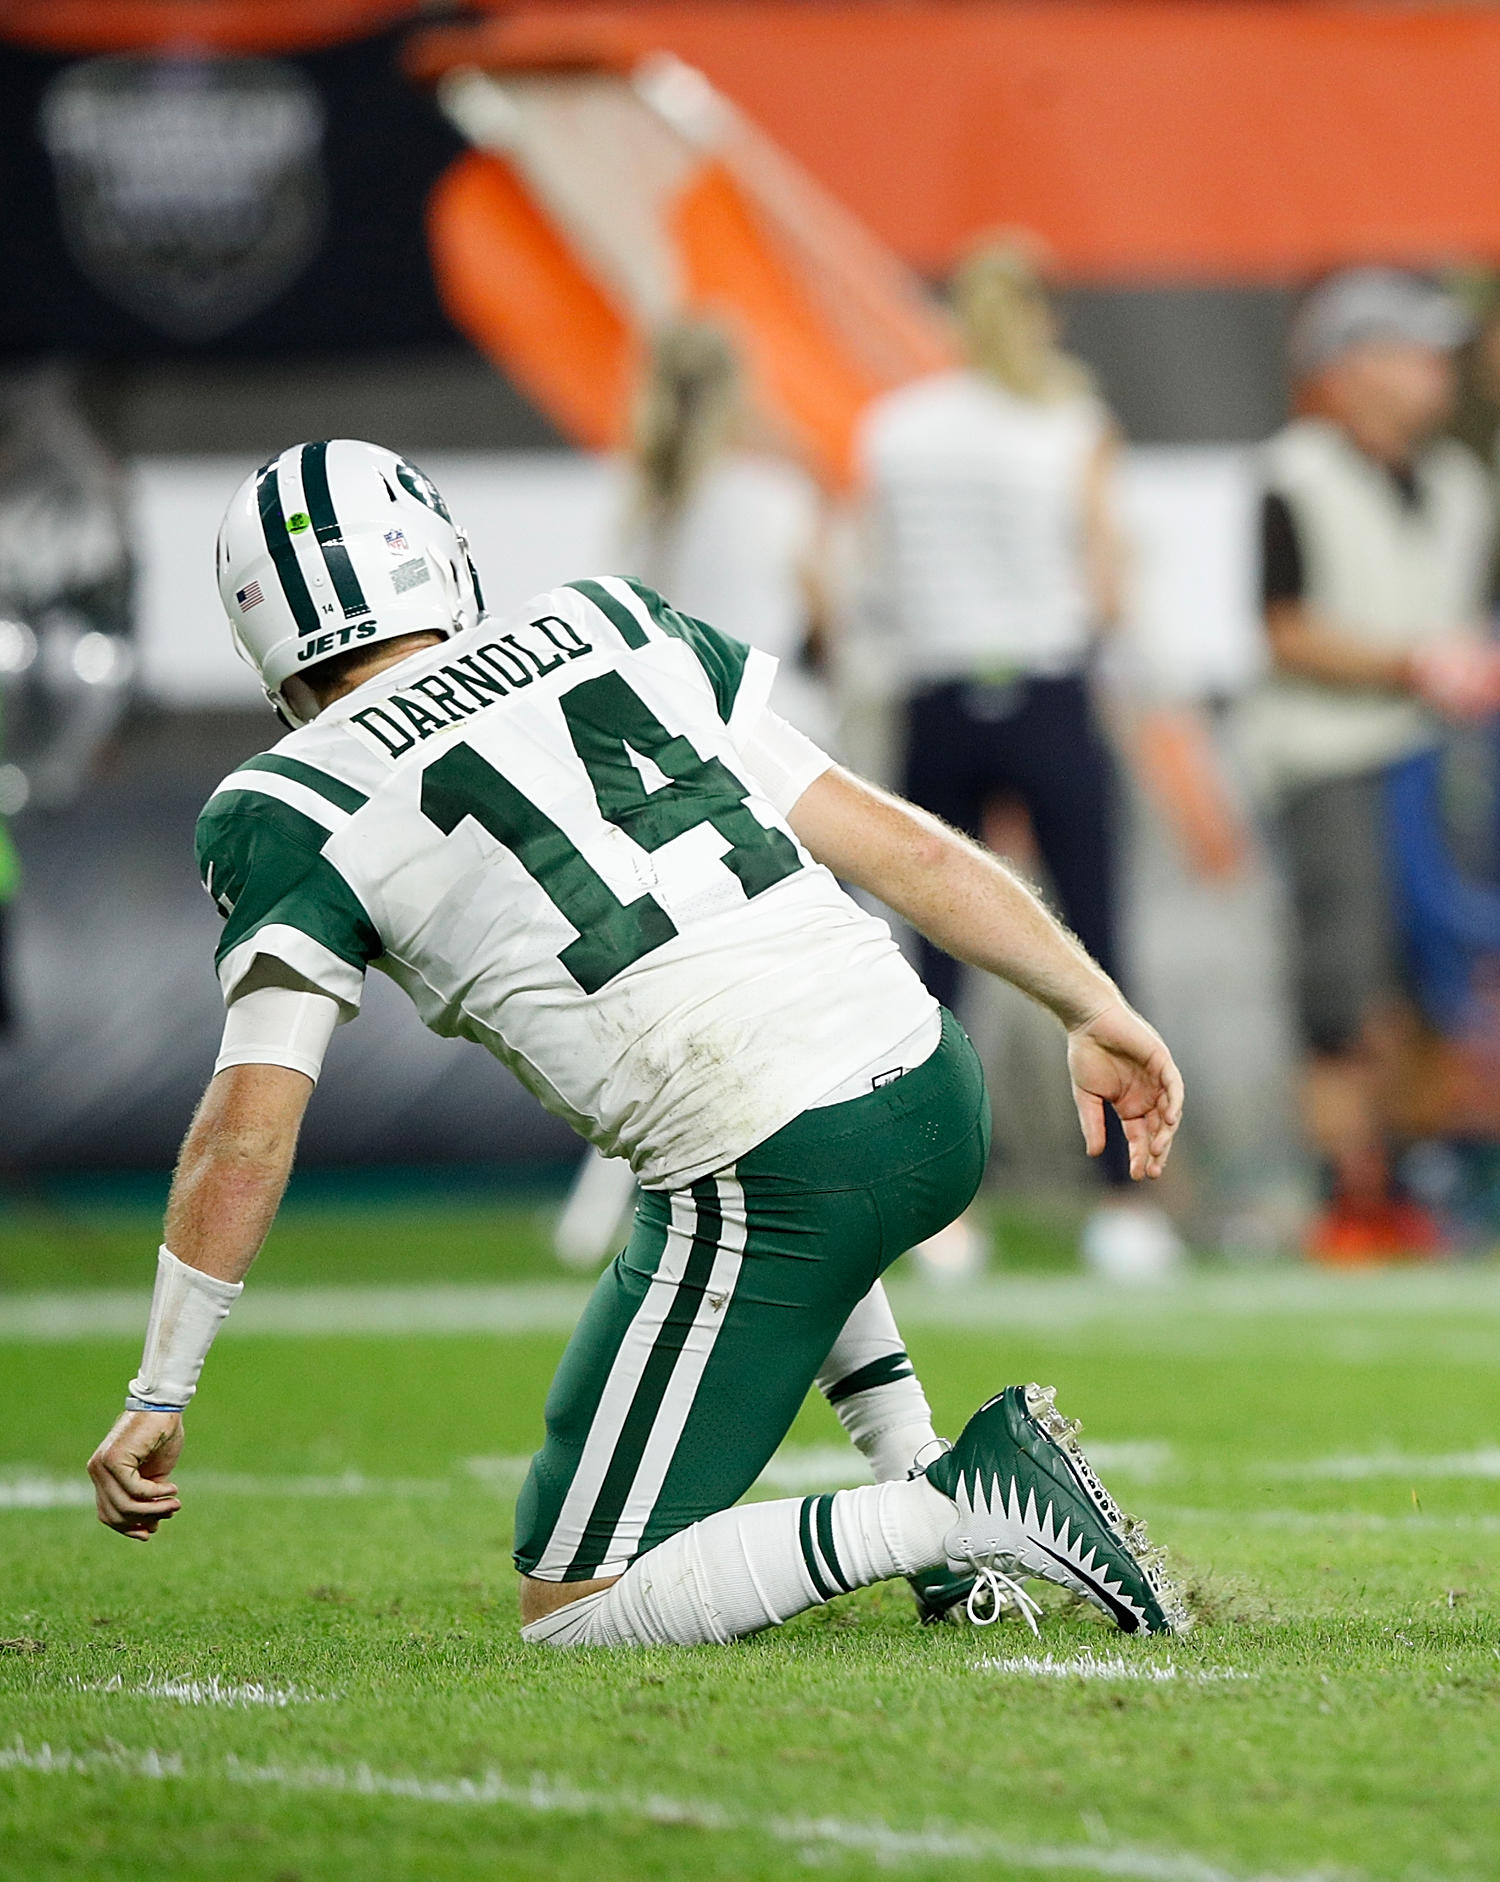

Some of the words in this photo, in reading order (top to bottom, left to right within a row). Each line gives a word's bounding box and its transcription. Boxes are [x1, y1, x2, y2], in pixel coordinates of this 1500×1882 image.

[297, 619, 378, 662] JETS
[321, 603, 335, 615] 14
[349, 615, 593, 760] DARNOLD
[419, 669, 804, 996] 14
